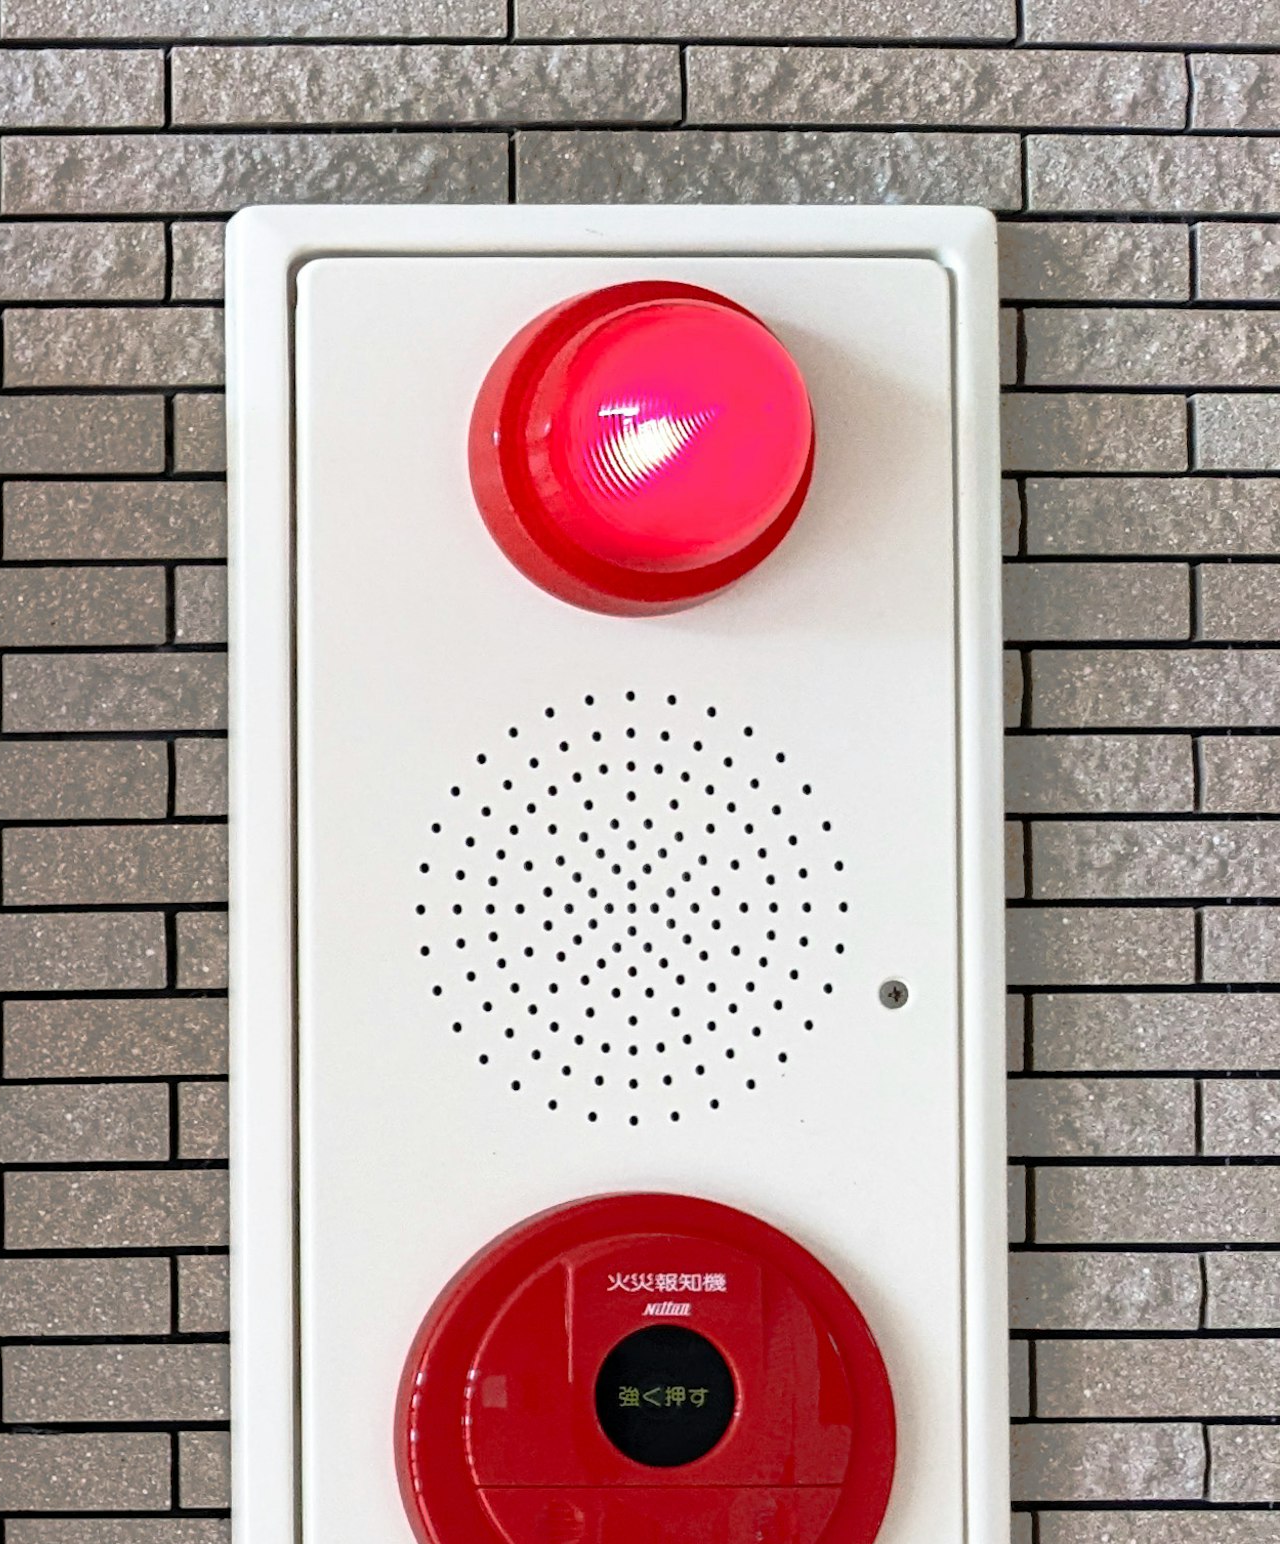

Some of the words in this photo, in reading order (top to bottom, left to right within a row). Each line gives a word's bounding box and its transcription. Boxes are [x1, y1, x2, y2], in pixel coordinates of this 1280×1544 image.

[606, 1272, 727, 1293] 火災報知機
[641, 1300, 691, 1317] Nittan
[618, 1385, 709, 1408] 強く押す
